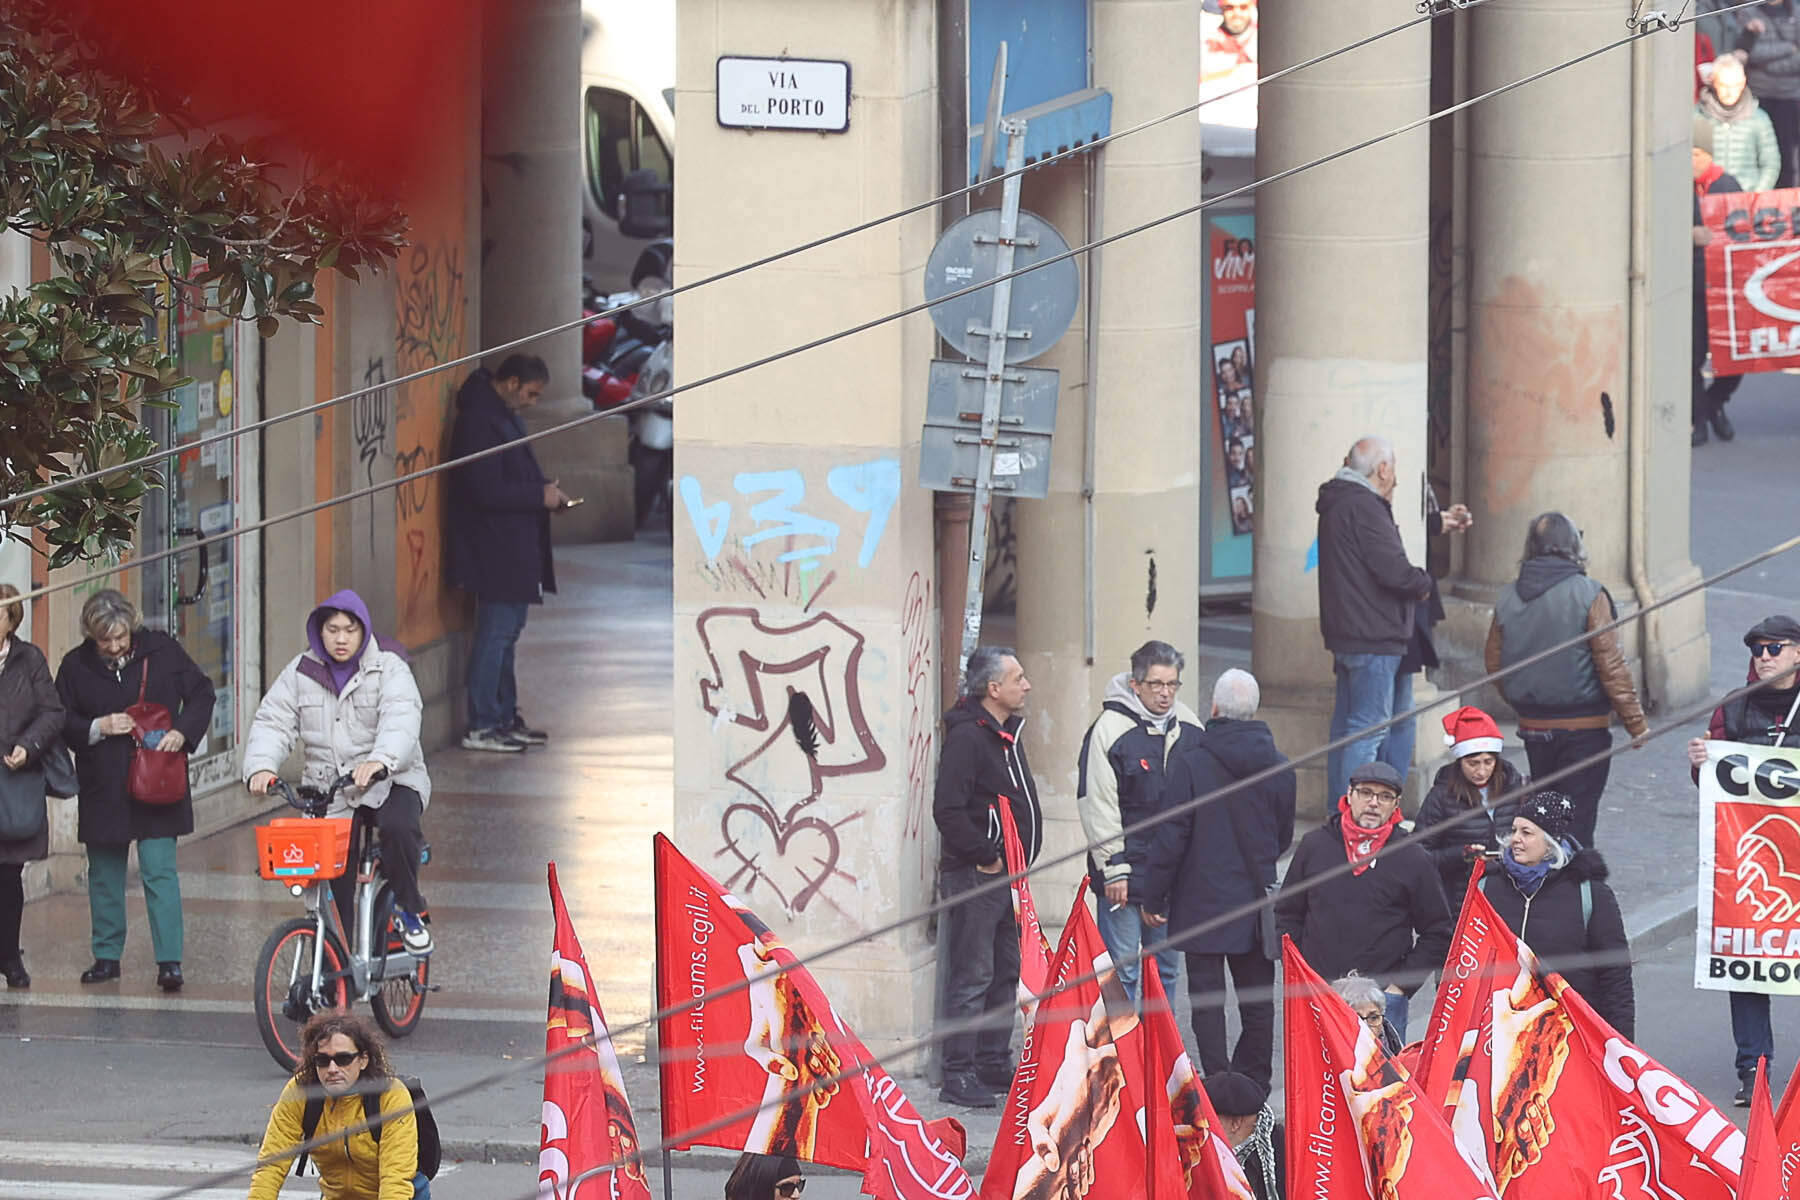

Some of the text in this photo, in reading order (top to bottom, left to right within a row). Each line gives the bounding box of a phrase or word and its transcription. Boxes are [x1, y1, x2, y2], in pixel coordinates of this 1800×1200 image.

[767, 72, 798, 89] VIA
[741, 97, 825, 117] DEL PORTO
